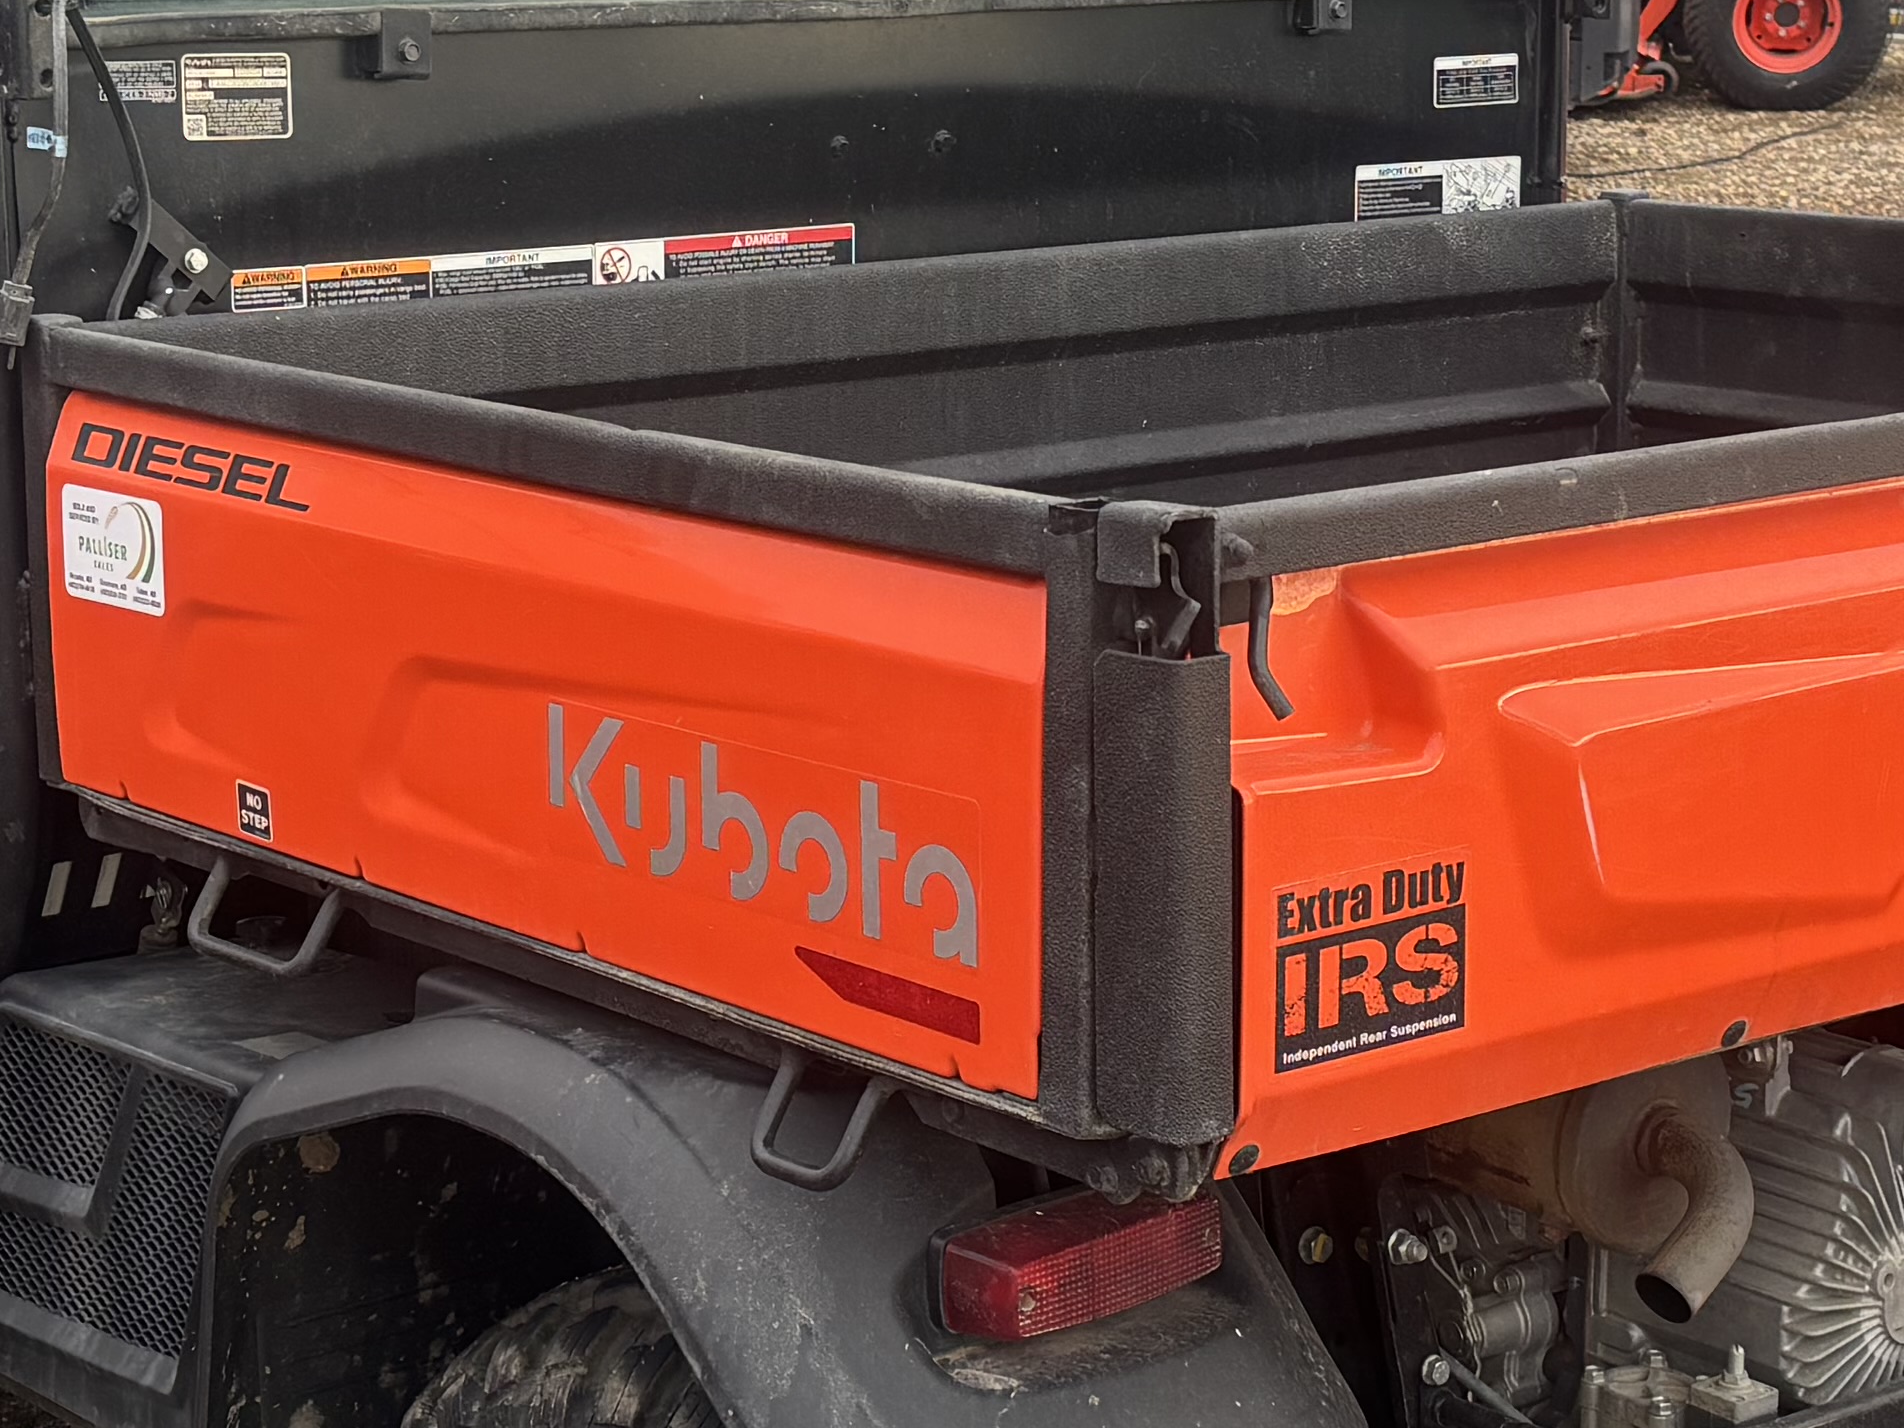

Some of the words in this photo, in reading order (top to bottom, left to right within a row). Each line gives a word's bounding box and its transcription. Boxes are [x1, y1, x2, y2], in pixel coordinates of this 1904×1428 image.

[745, 232, 789, 246] DANGER
[350, 263, 397, 275] WARNING
[485, 253, 539, 265] IMPORTANT
[250, 271, 295, 283] WARNING
[71, 422, 310, 512] DIESEL
[78, 535, 127, 561] PALLISER
[93, 560, 114, 572] SALES
[246, 792, 262, 810] NO
[241, 809, 269, 830] STEP
[548, 702, 978, 968] Kubota
[1277, 883, 1372, 940] Extra
[1382, 861, 1465, 916] Duty
[1284, 922, 1459, 1037] IRS
[1282, 1036, 1357, 1065] Independent
[1360, 1030, 1388, 1046] Rear
[1390, 1012, 1457, 1038] Suspension
